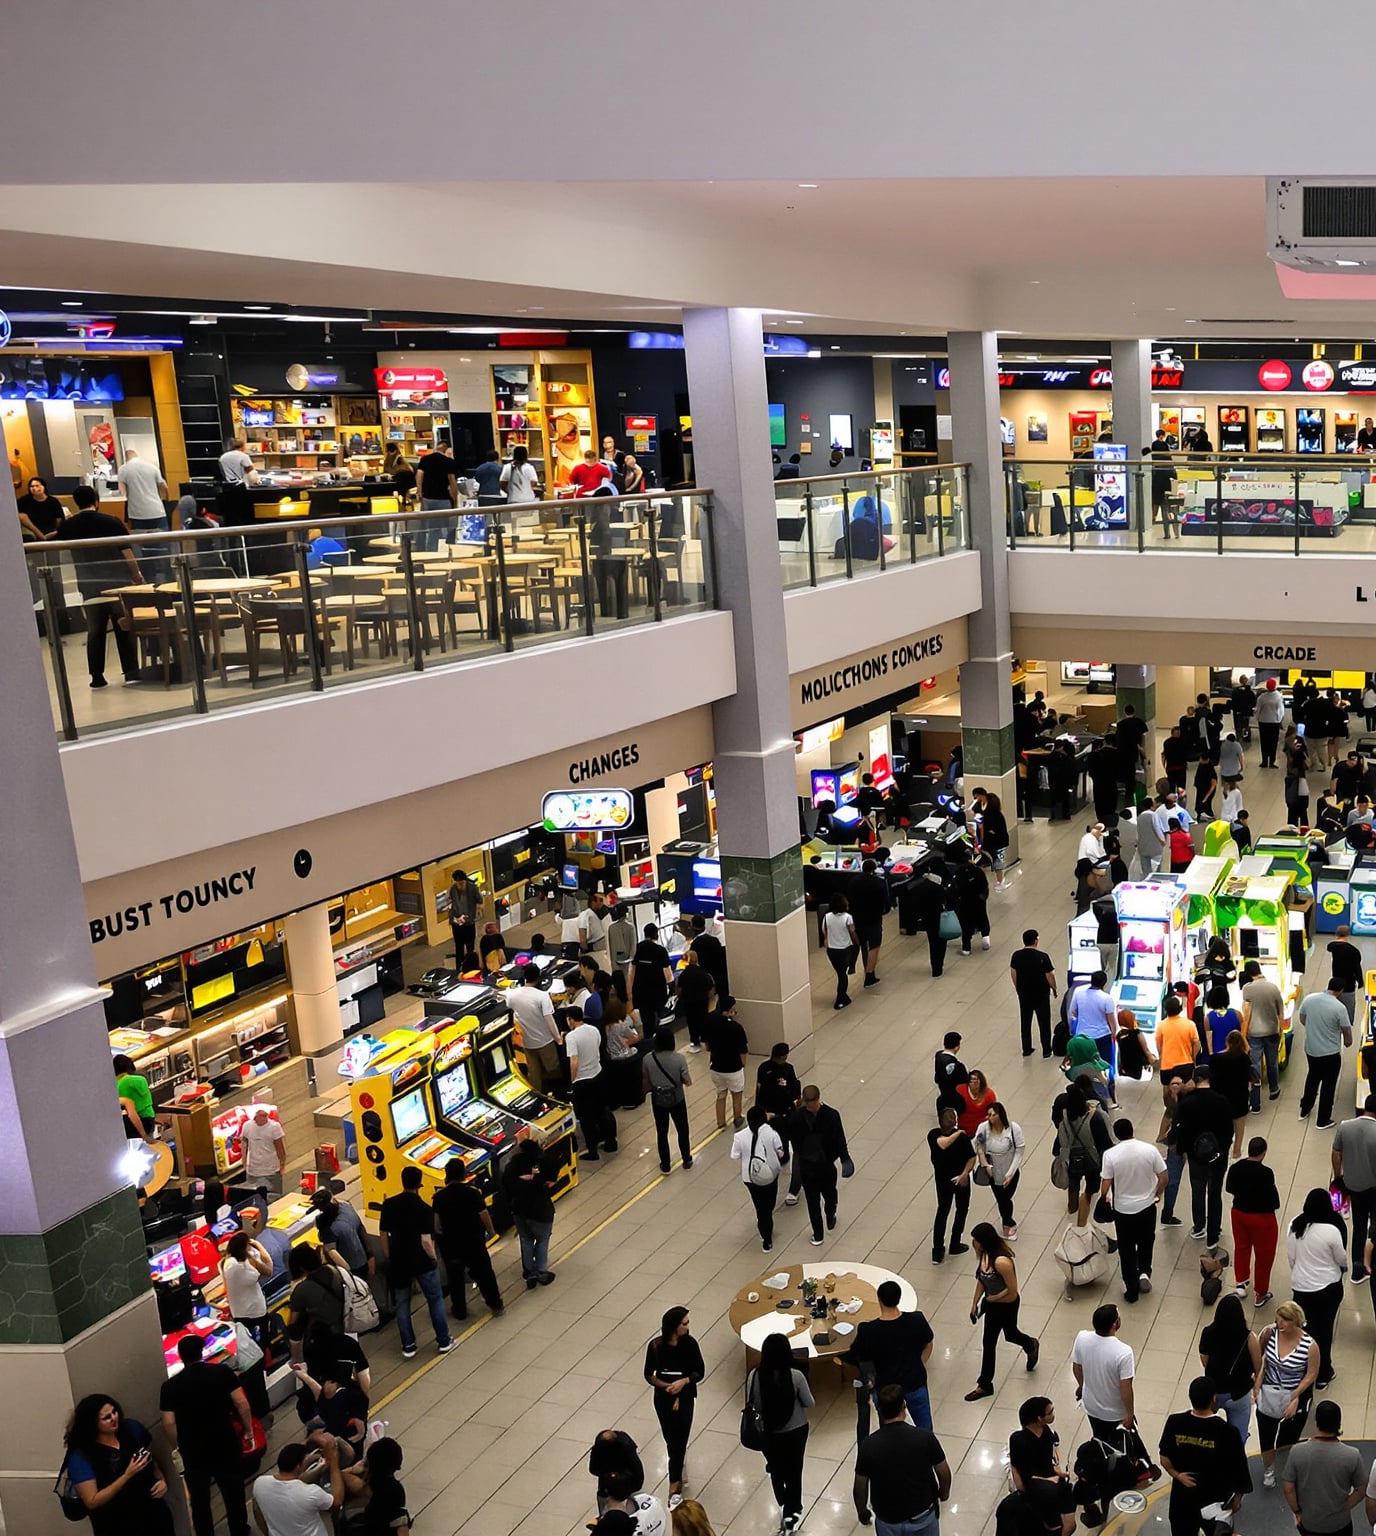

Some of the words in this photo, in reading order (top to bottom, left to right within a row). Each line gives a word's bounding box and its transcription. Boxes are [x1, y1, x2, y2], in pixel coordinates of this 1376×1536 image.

[1253, 645, 1316, 661] CRCADE
[569, 743, 639, 784] CHANGES
[88, 902, 153, 944] BUST
[160, 866, 257, 919] TOUNCY
